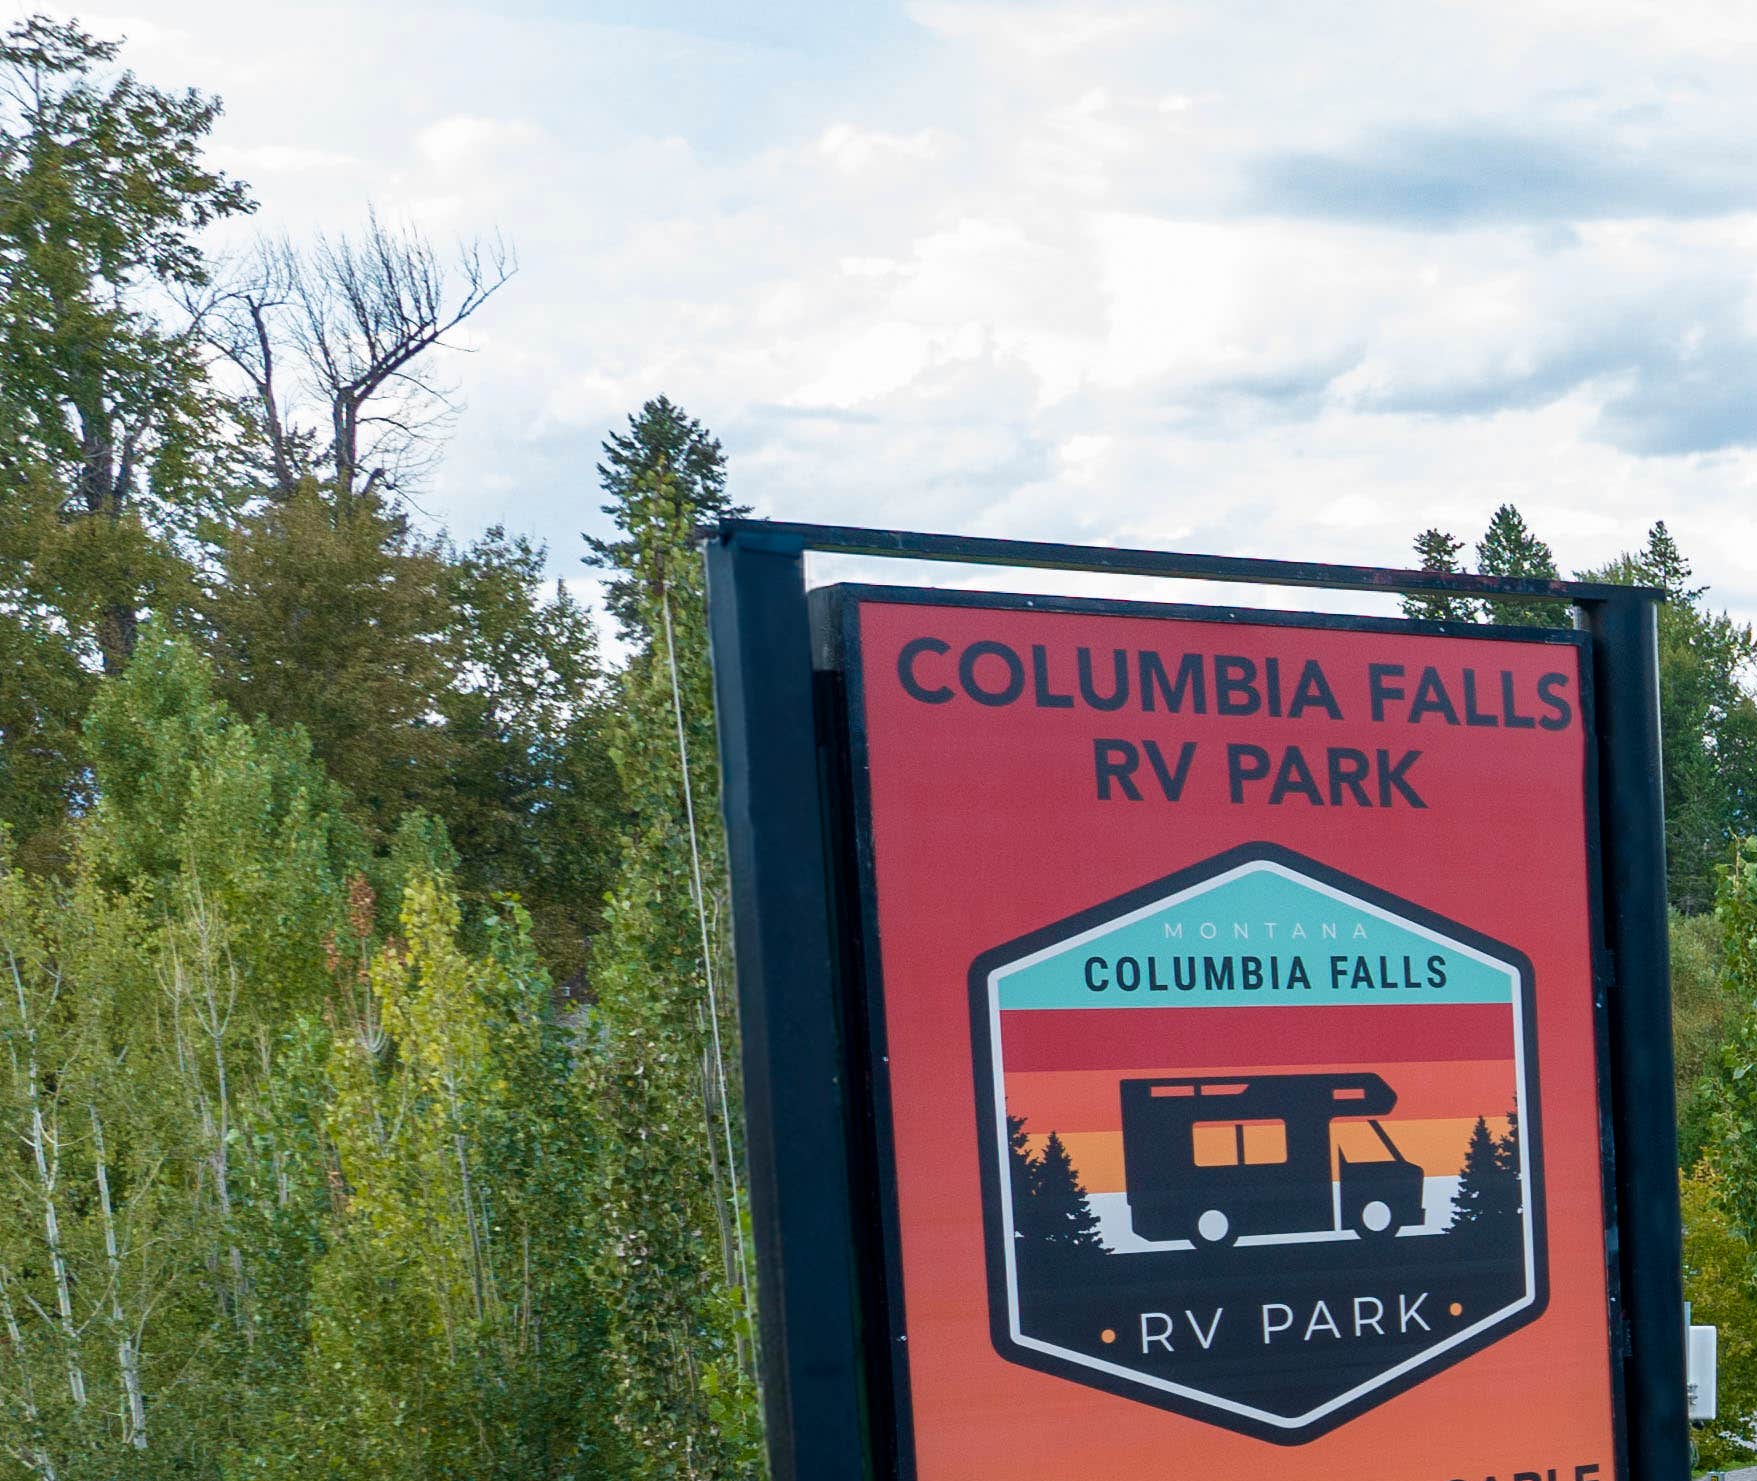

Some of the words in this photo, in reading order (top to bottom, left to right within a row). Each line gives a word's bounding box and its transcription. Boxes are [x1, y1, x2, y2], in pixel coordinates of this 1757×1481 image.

[897, 637, 1344, 721] COLUMBIA
[1369, 662, 1573, 732] FALLS
[1092, 738, 1198, 803] RV
[1227, 744, 1429, 809] PARK
[1163, 920, 1369, 941] MONTANA
[1084, 955, 1311, 993] COLUMBIA
[1329, 954, 1448, 990] FALLS
[1140, 1307, 1224, 1355] RV
[1262, 1292, 1432, 1345] PARK
